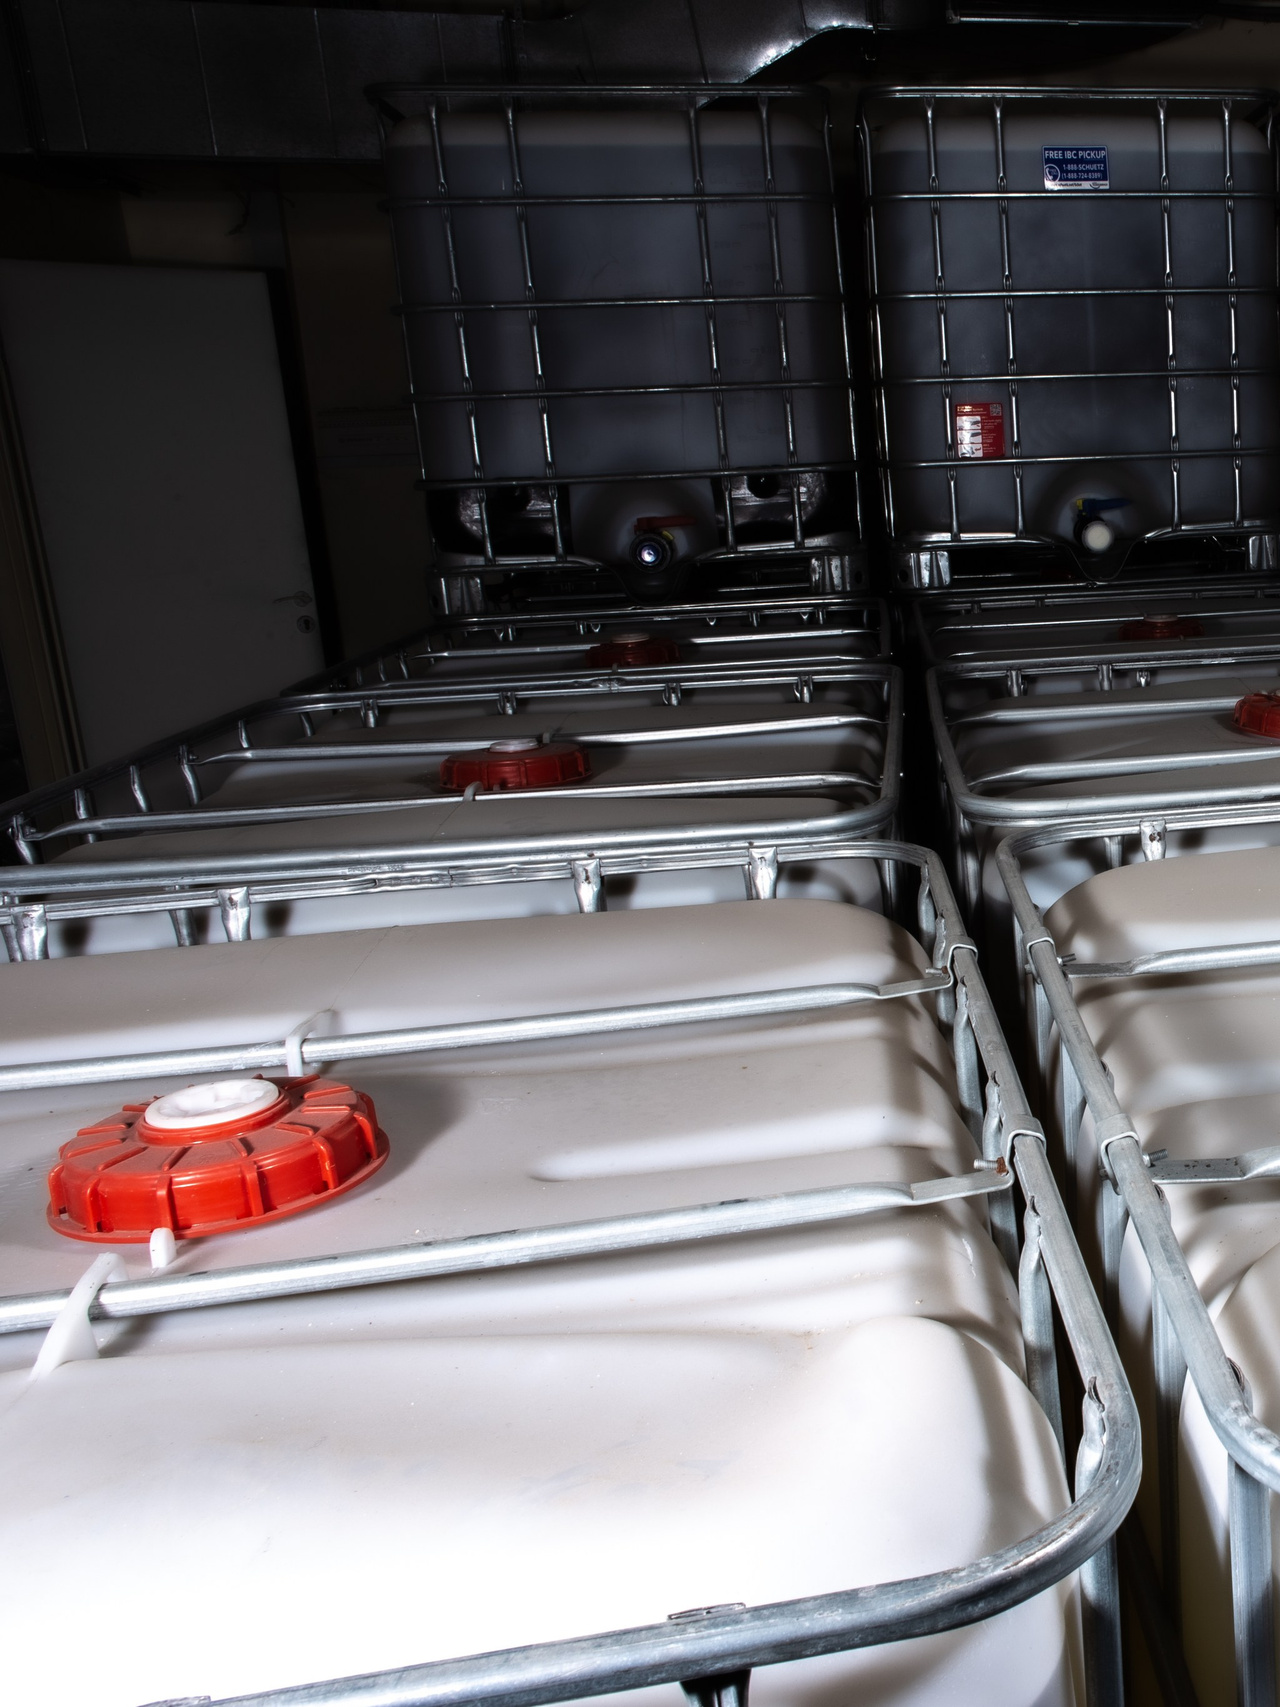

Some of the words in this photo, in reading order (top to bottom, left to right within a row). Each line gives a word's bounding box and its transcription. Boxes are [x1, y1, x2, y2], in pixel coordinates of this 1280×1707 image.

[1045, 150, 1063, 159] FREE
[1064, 150, 1077, 159] IBC
[1078, 150, 1106, 159] PICKUP
